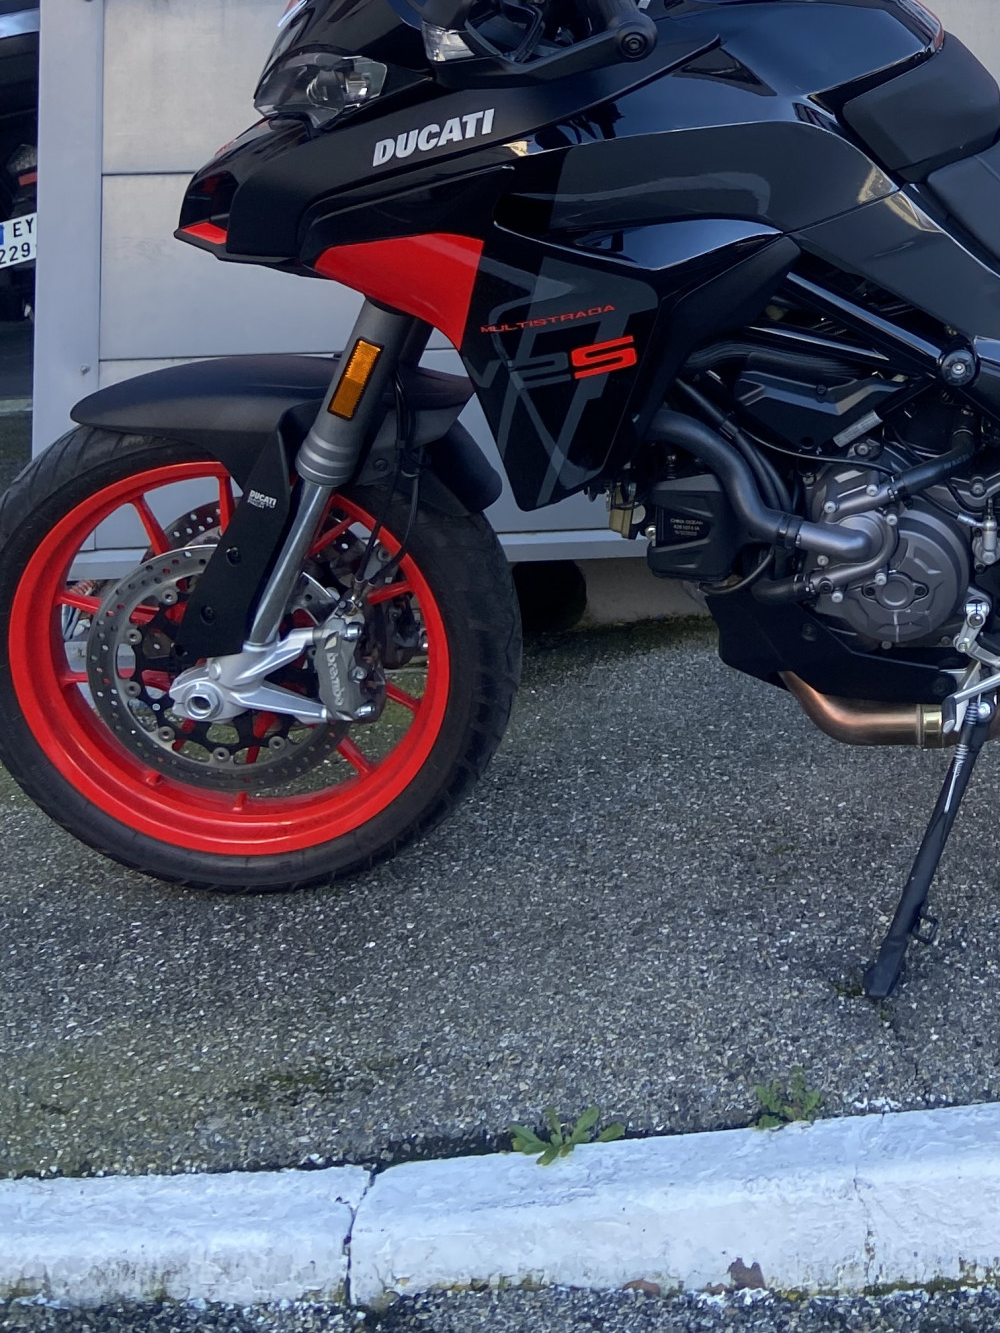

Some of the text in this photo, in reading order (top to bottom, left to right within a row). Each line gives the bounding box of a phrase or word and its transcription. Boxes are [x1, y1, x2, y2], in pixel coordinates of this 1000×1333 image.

[372, 108, 495, 167] DUCATI
[13, 217, 34, 238] EY
[480, 304, 616, 333] MULTISTRADA
[249, 489, 277, 507] DUCATI
[325, 652, 346, 706] brembo
